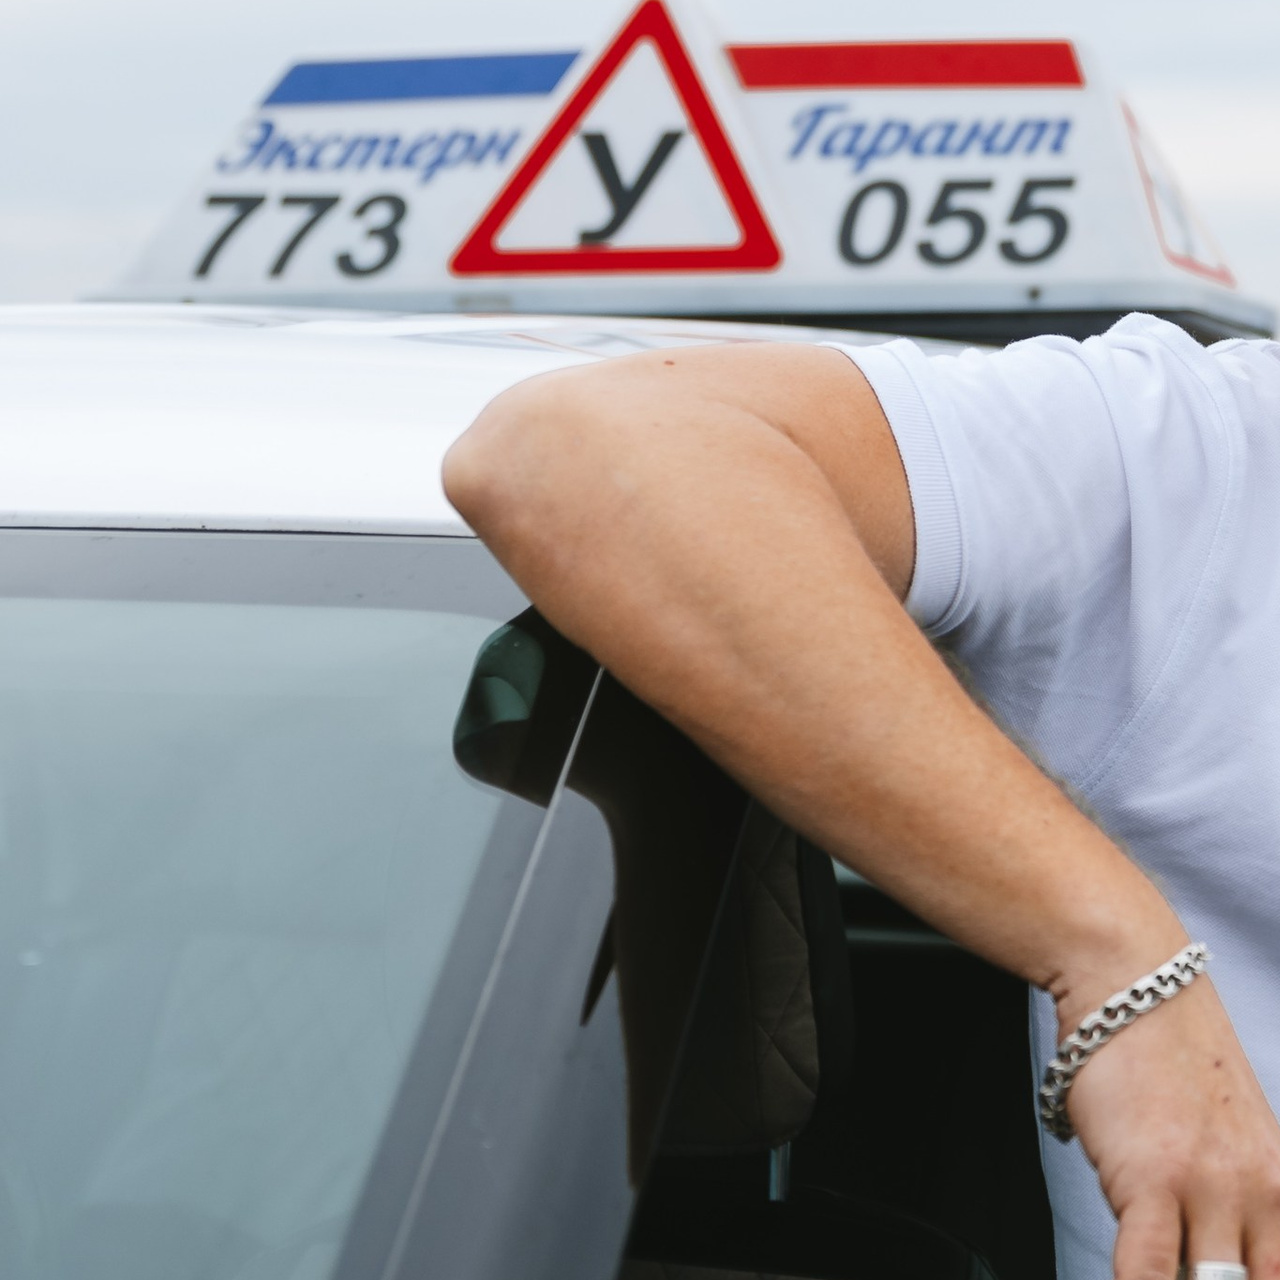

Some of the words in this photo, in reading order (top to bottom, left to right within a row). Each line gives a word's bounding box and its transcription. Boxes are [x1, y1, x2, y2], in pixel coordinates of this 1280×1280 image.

[217, 119, 523, 183] Экстерн
[787, 103, 1074, 173] Гарант
[577, 131, 684, 246] У
[839, 177, 1076, 265] 055
[194, 193, 409, 278] 773
